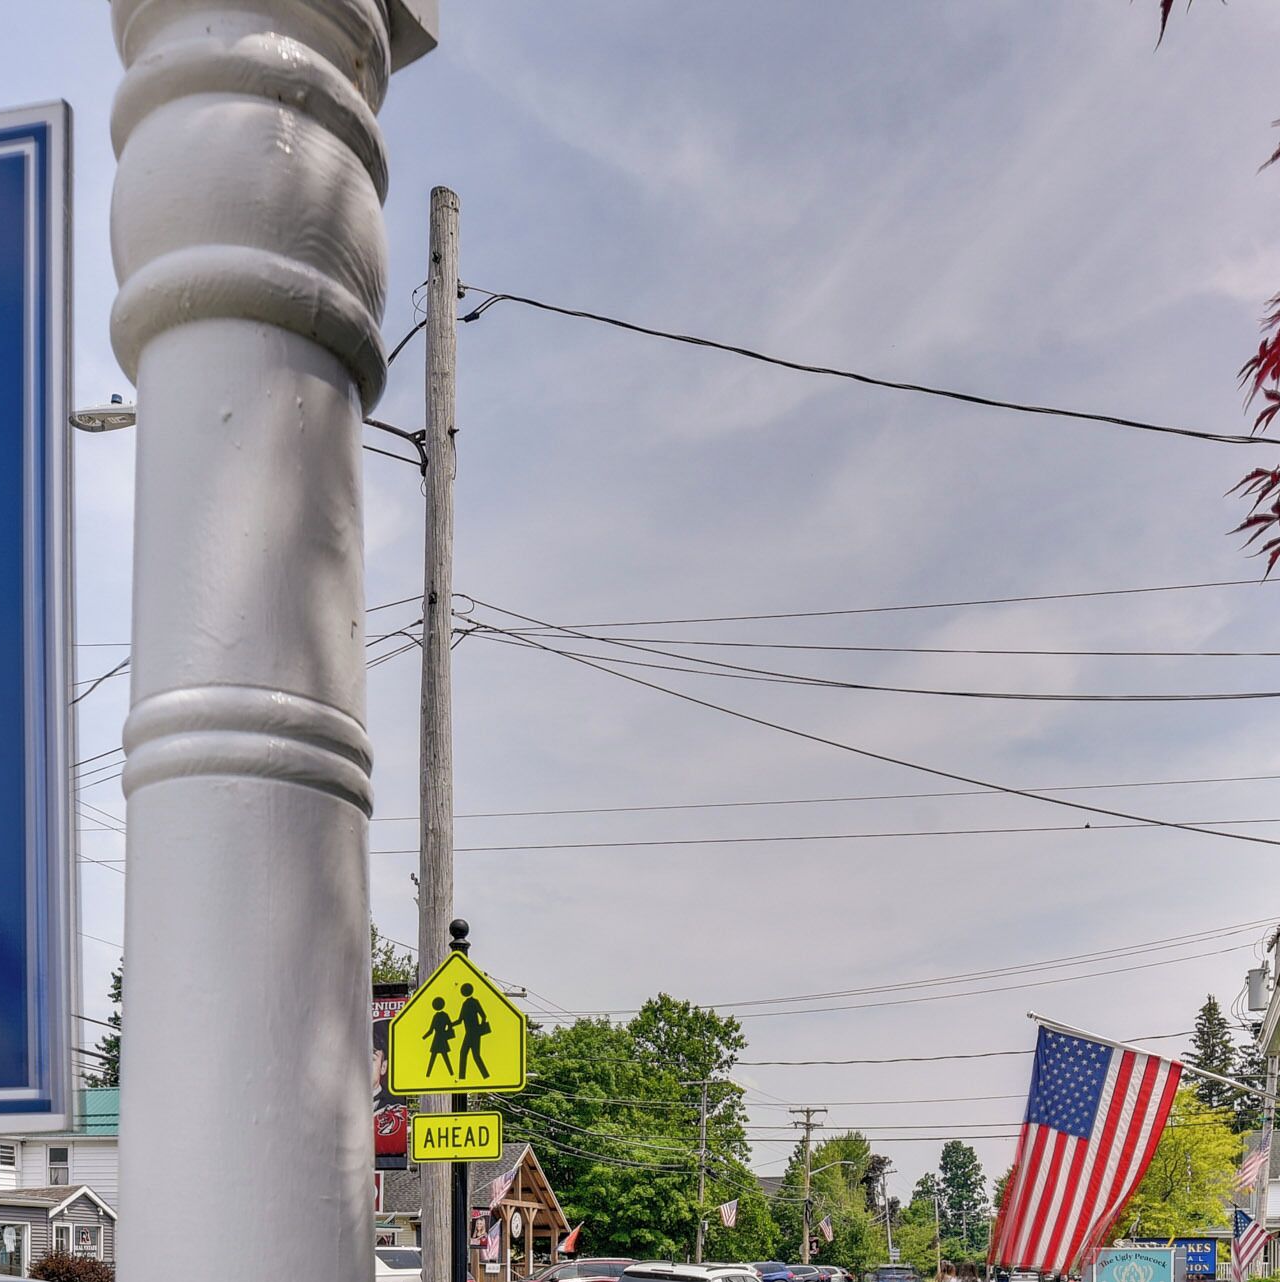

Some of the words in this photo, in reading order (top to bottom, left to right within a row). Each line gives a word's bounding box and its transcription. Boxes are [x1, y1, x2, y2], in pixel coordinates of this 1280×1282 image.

[371, 1001, 405, 1010] NIOR
[424, 1126, 490, 1149] AHEAD
[1099, 1259, 1114, 1268] The
[1115, 1253, 1133, 1262] Ugly
[1135, 1253, 1167, 1268] Peacock
